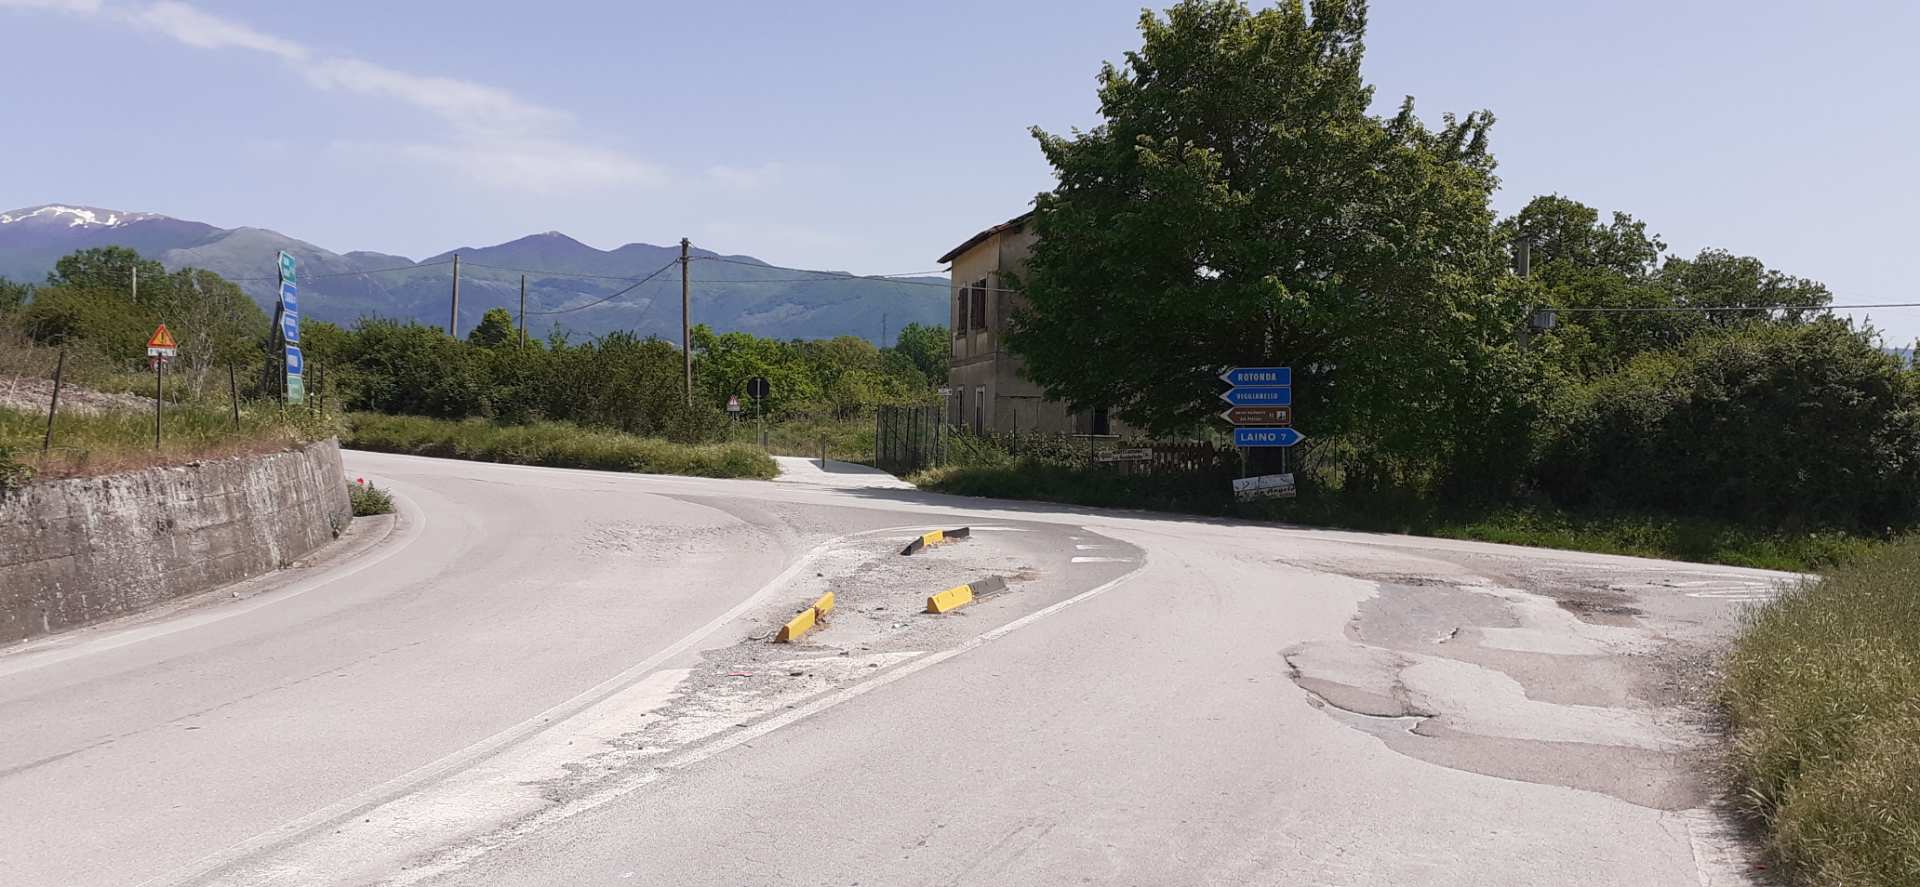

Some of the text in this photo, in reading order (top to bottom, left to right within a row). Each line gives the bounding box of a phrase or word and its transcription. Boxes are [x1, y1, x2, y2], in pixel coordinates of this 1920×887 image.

[1237, 373, 1277, 382] ROTONDA
[1240, 432, 1287, 441] LAINO 7
